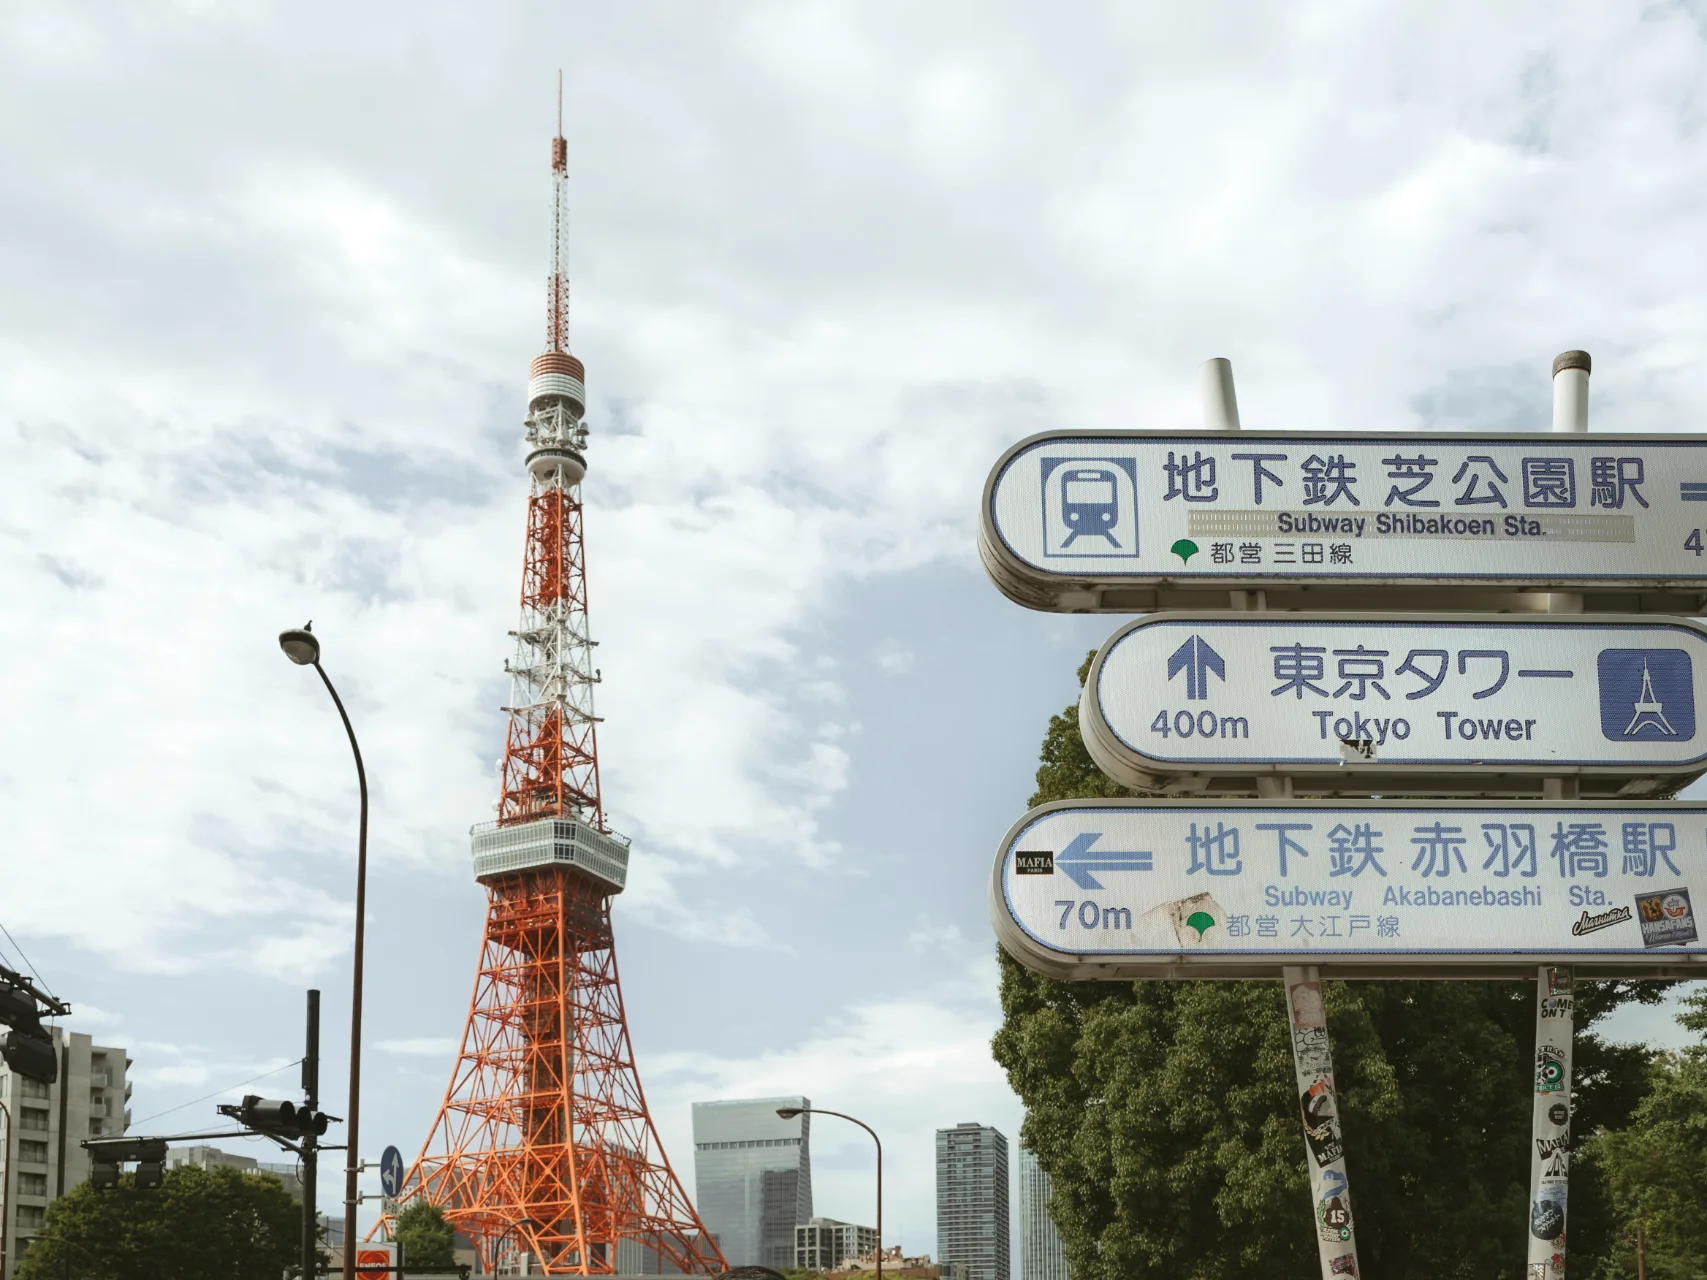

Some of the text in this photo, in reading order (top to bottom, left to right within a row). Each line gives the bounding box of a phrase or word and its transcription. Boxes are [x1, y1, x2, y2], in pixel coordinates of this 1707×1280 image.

[1277, 511, 1547, 538] Subway Shibakoen Sta.
[1268, 641, 1575, 702] 東京タワー
[1150, 709, 1250, 740] 400m
[1311, 710, 1538, 746] Tokyo Tower
[1016, 857, 1053, 868] MAFIA
[1264, 884, 1613, 911] Subway Akabanebashi Sta.
[1054, 900, 1133, 930] 70m
[1330, 1210, 1345, 1224] 15
